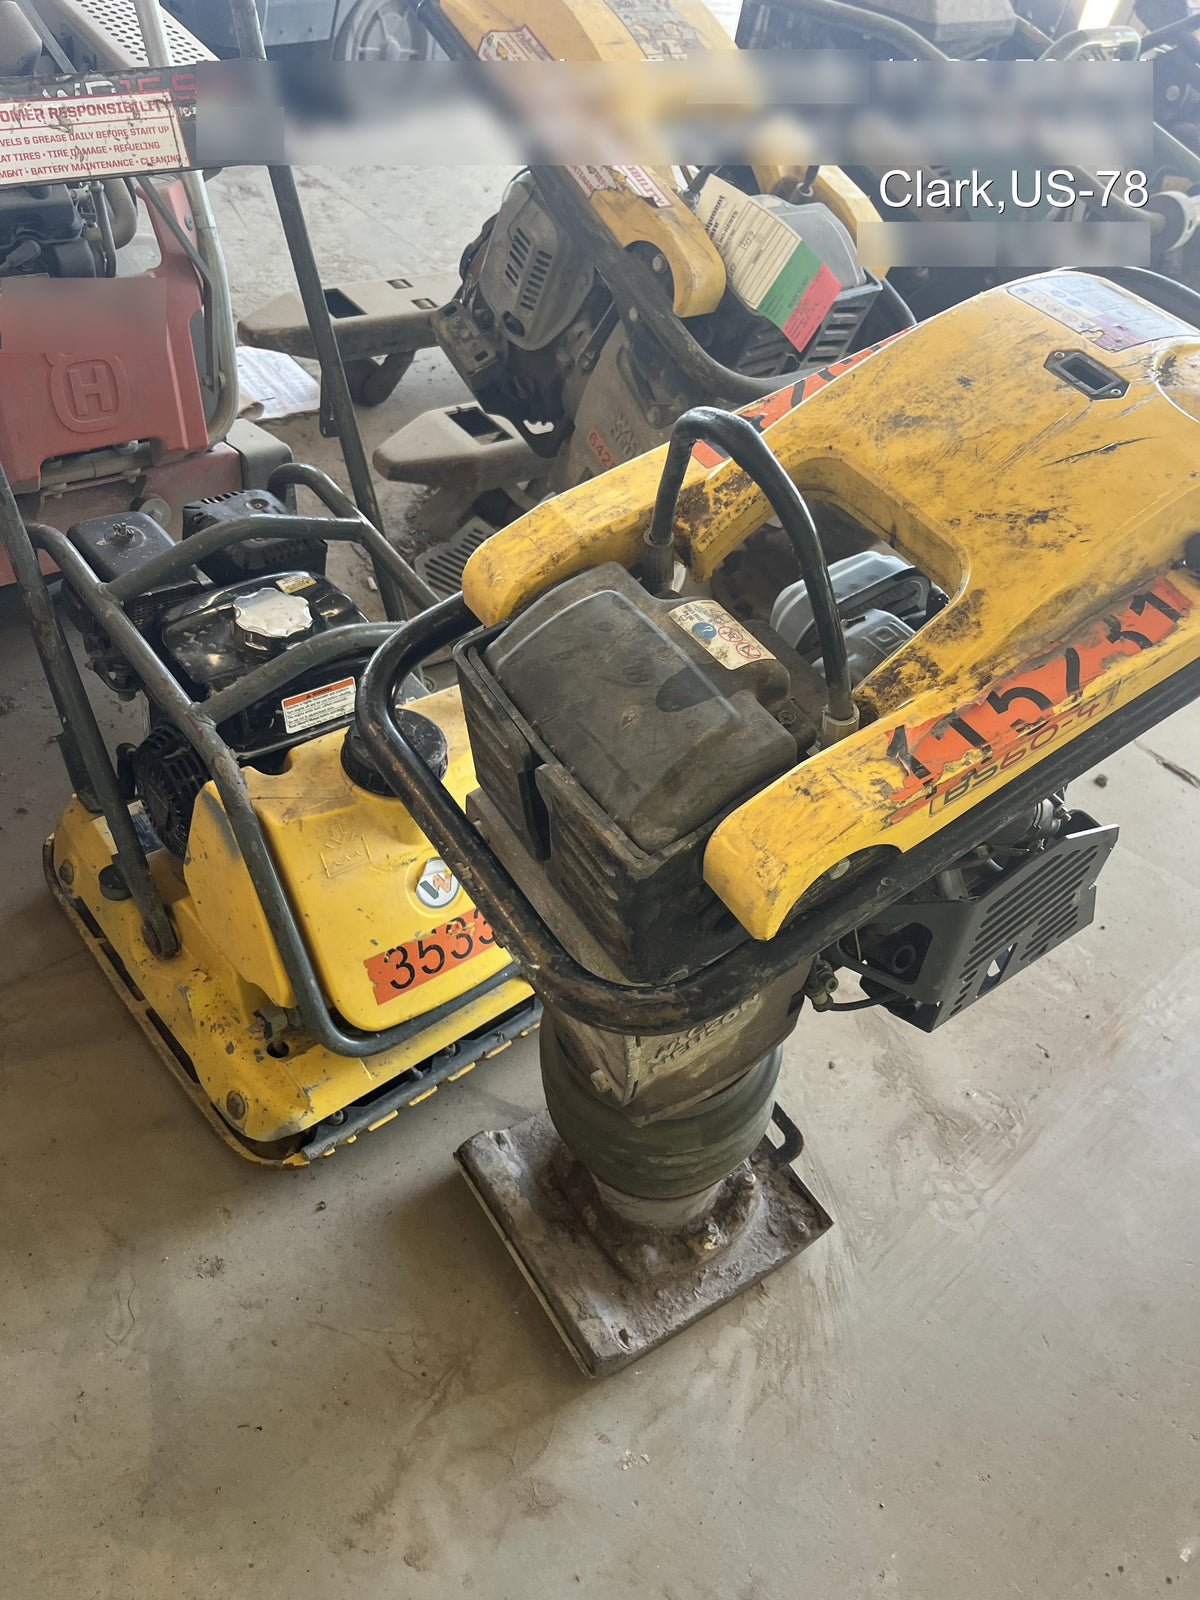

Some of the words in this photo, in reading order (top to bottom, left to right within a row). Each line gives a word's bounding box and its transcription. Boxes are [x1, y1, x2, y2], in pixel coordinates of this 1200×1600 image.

[32, 134, 67, 145] GREASE
[69, 131, 94, 141] DAILY
[96, 128, 129, 139] BEFORE
[130, 127, 157, 136] START
[158, 126, 169, 134] UP
[13, 151, 41, 161] TIRES
[47, 149, 69, 159] TIRE
[71, 146, 107, 157] DAMAGE
[113, 141, 161, 152] REFUELING
[31, 164, 69, 175] BATTERY
[72, 158, 134, 171] MAINTENANCE
[141, 154, 181, 166] CLEANING
